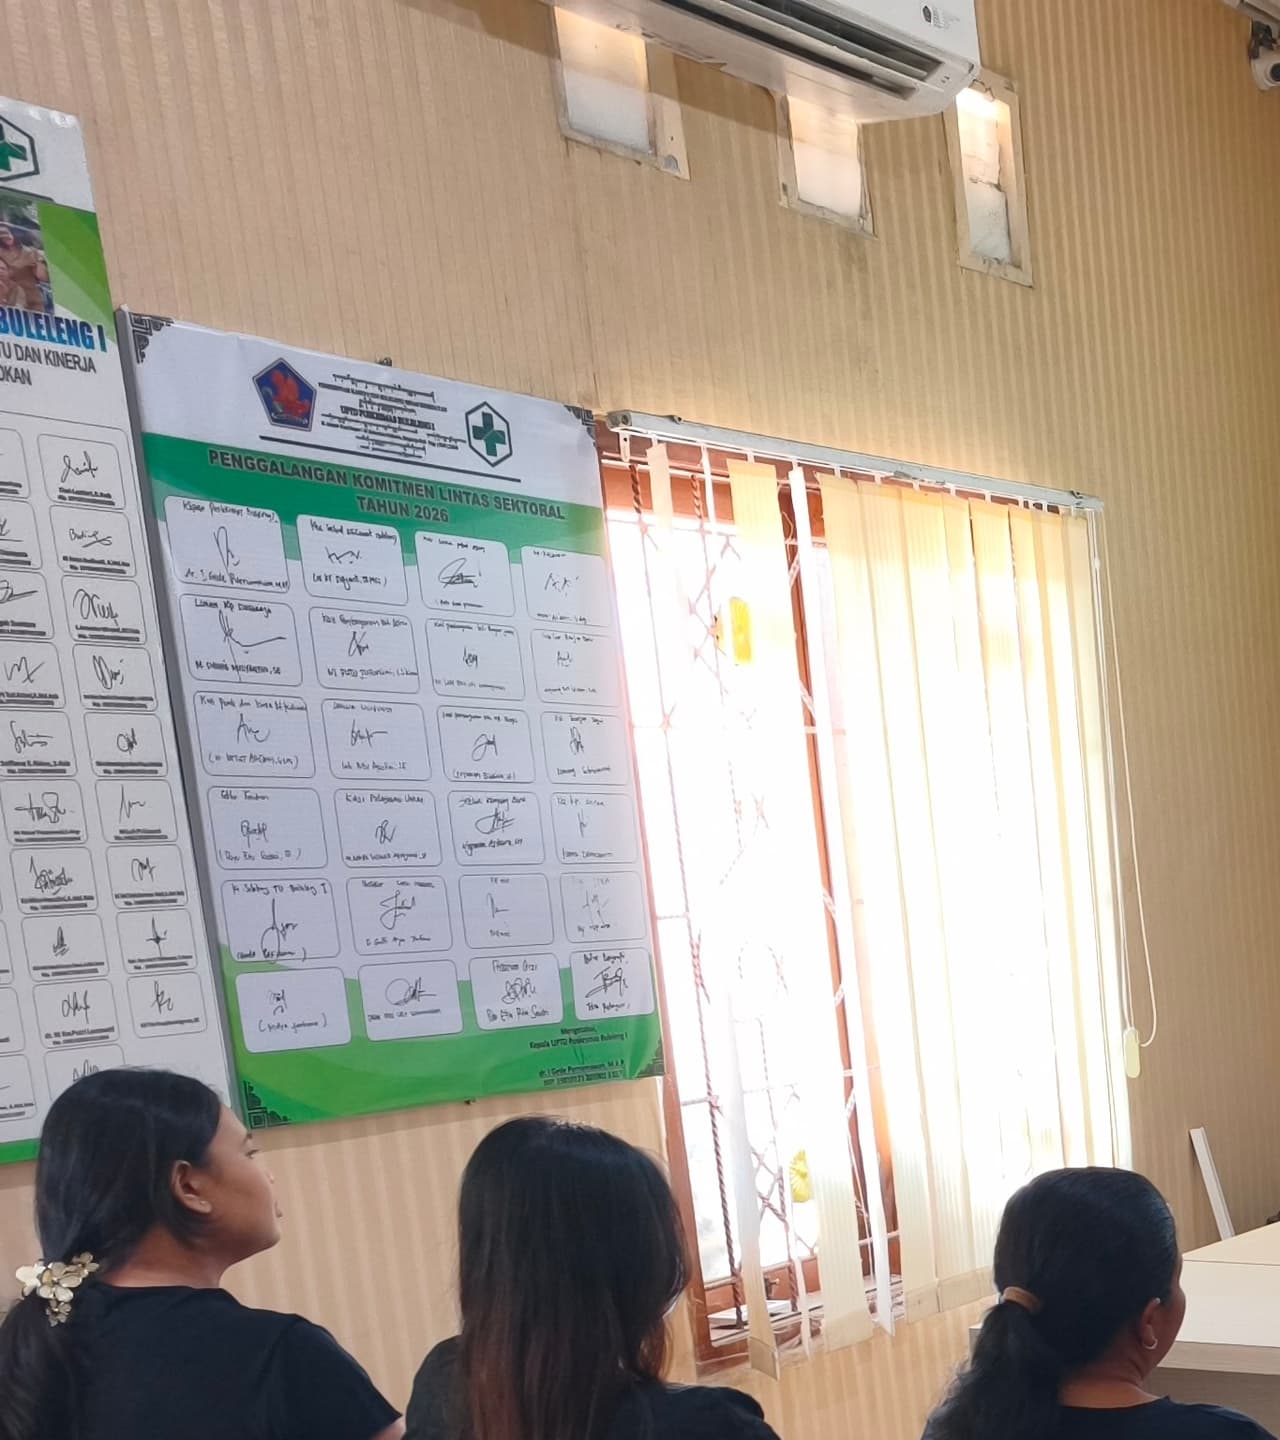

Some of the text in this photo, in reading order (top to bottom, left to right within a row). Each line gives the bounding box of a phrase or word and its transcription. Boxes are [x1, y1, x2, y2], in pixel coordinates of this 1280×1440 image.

[0, 307, 107, 353] BULELENG I
[13, 343, 43, 365] DAN
[43, 348, 97, 374] KINERJA
[207, 447, 566, 520] PENGGALANGAN KOMITMEN LINTAS SEKTORAL
[356, 495, 450, 525] TAHUN 2026
